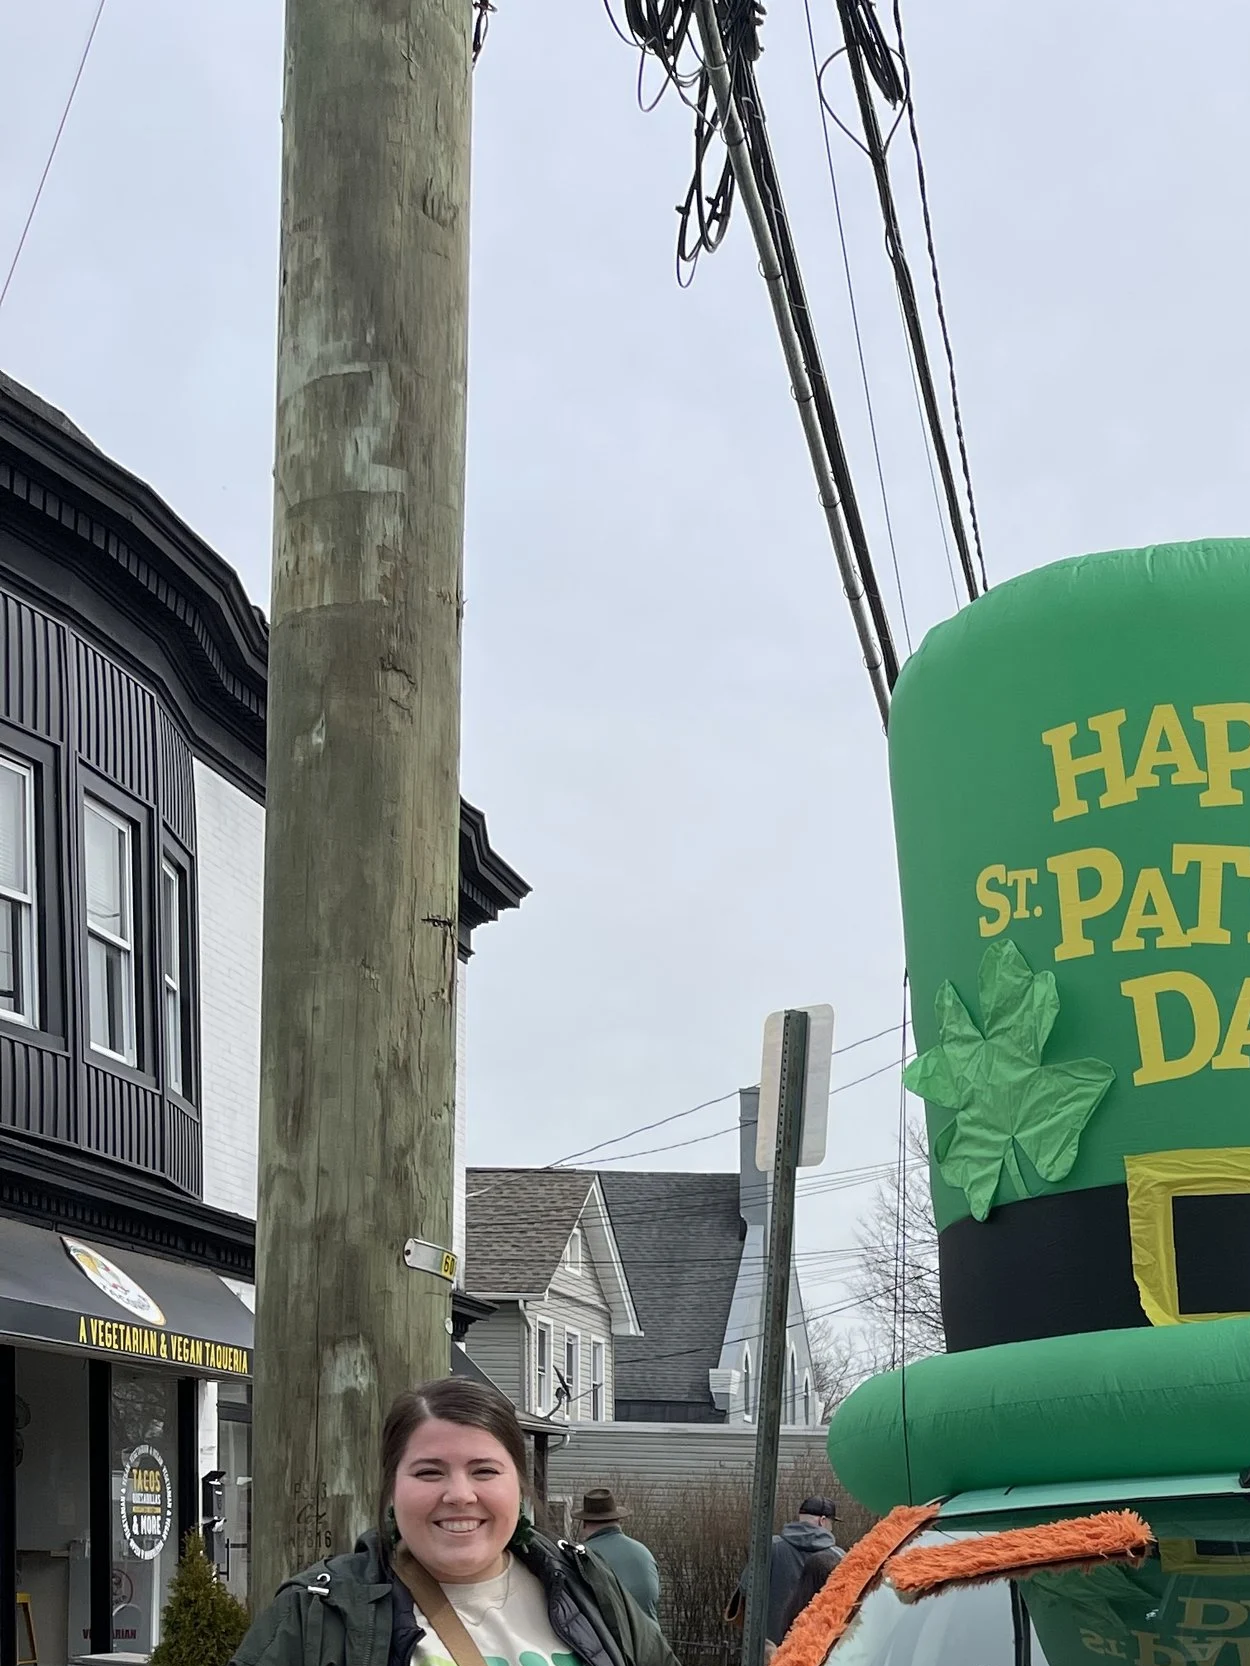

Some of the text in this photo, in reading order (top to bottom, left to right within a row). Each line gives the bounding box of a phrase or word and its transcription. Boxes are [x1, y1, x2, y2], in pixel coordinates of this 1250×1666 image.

[78, 1315, 248, 1374] A VEGETARIAN & VEGAN TAQUERIA
[132, 1468, 161, 1493] TACOS
[132, 1514, 161, 1536] & MORE
